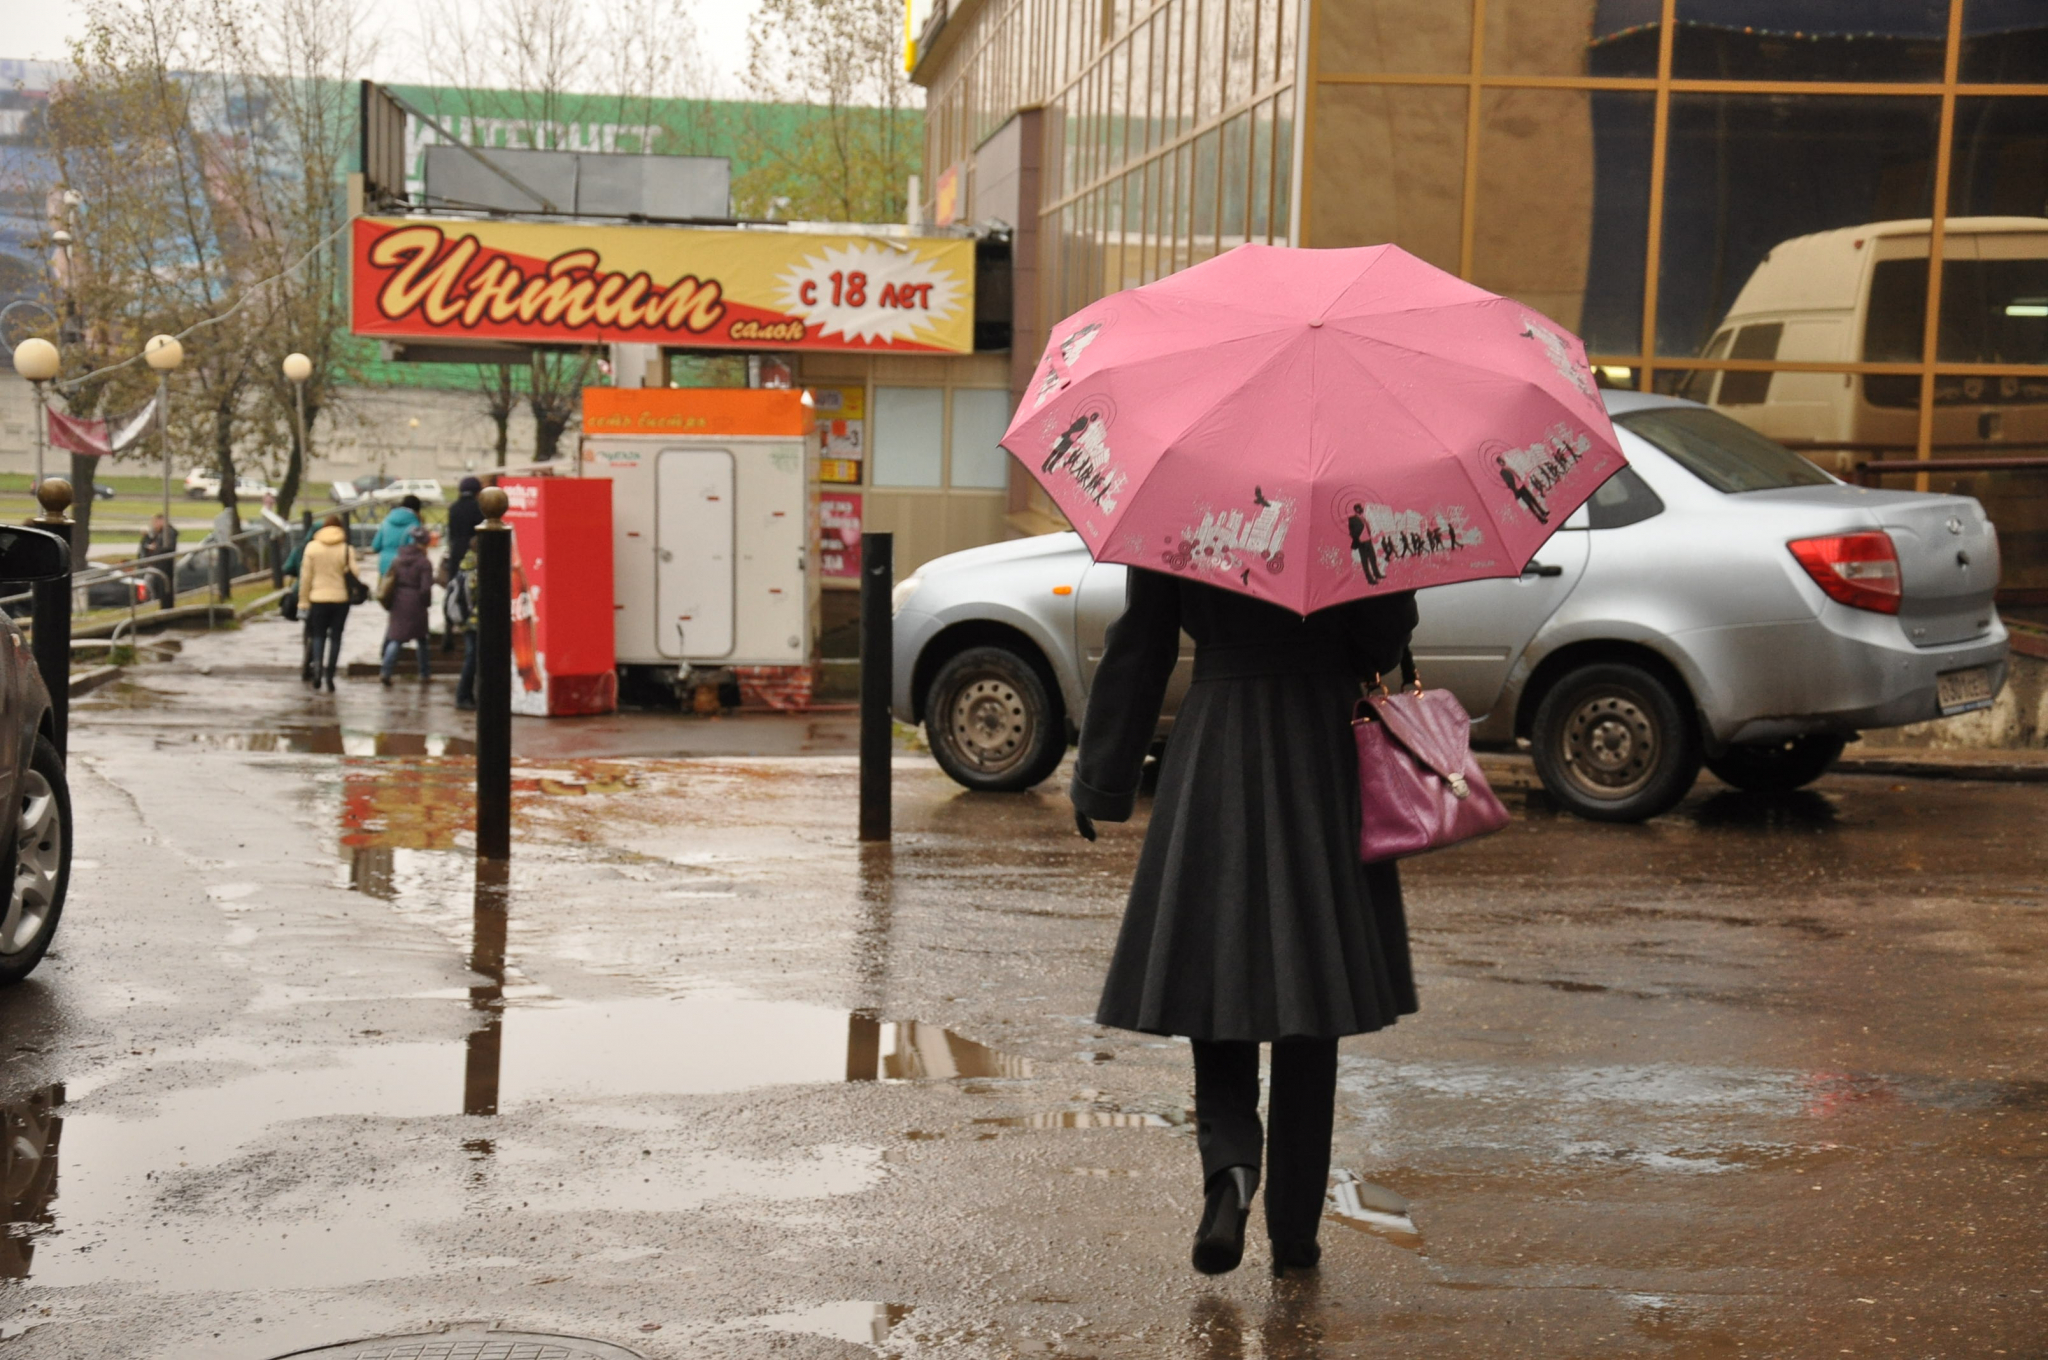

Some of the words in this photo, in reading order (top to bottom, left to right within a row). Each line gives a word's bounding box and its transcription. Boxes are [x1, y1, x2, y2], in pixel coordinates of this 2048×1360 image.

[369, 225, 726, 333] Интим
[829, 270, 867, 308] 18
[878, 281, 935, 310] лет
[728, 319, 805, 342] салон
